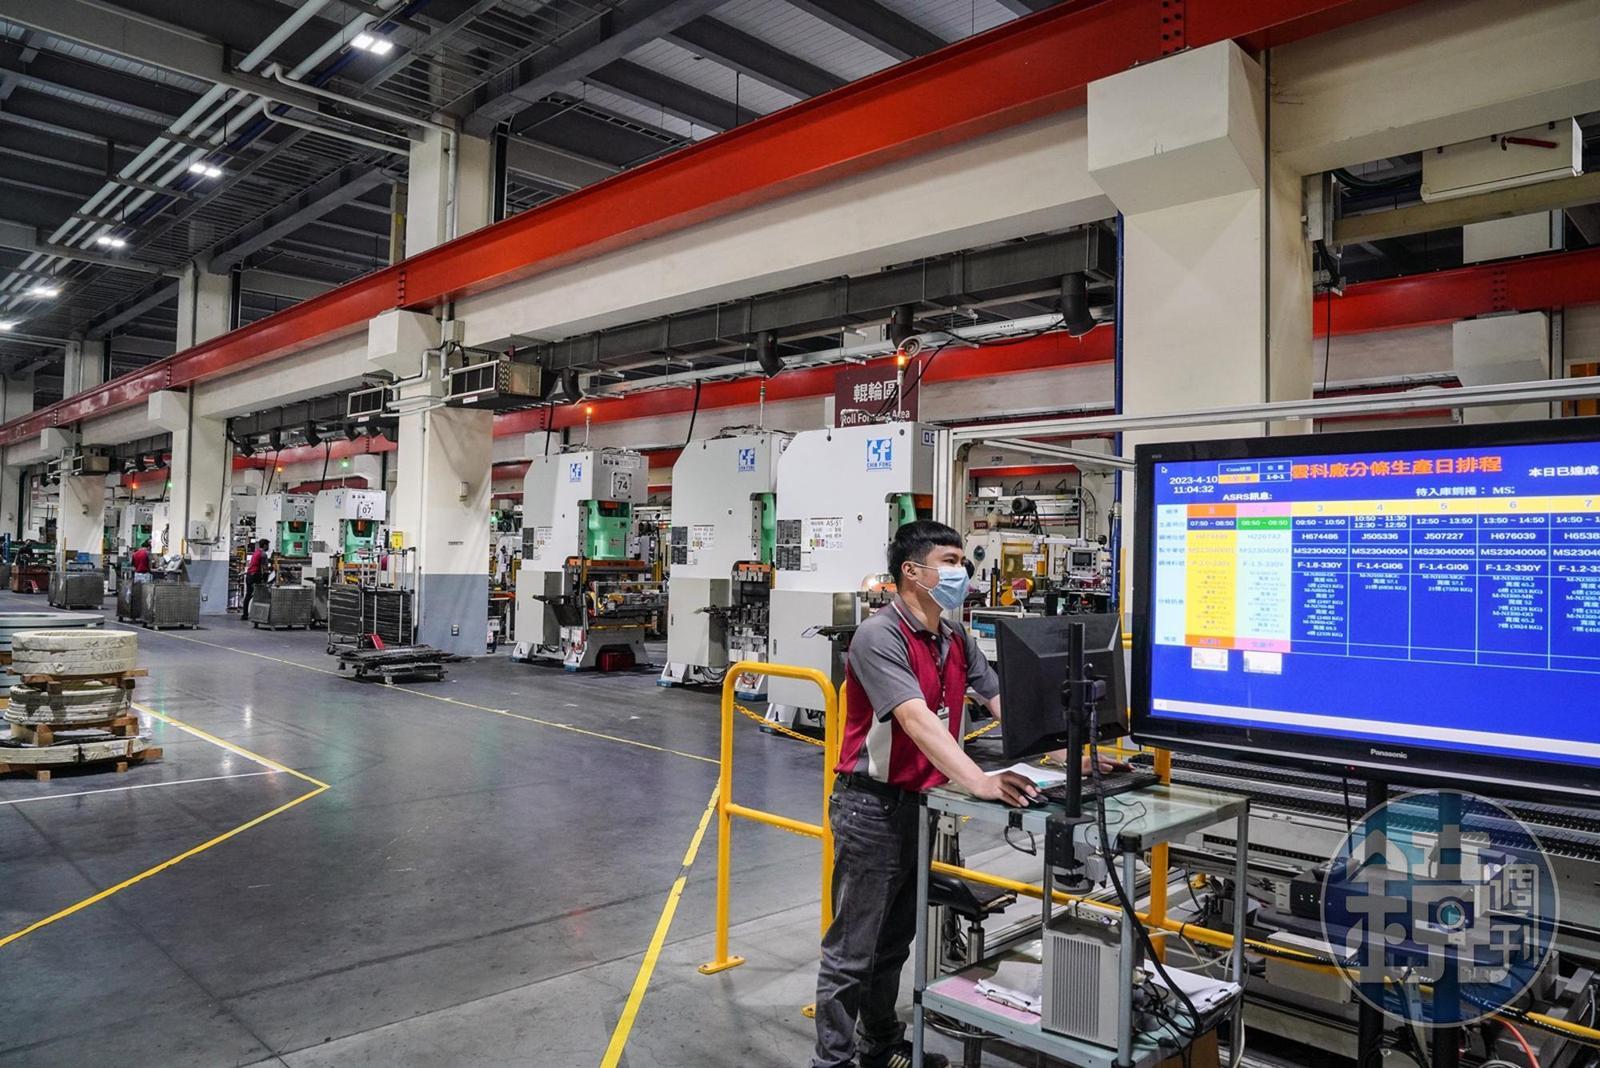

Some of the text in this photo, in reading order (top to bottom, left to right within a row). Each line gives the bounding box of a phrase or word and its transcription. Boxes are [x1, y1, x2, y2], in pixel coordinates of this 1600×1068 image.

[1169, 475, 1218, 485] 2023-4-10
[617, 480, 629, 490] 74
[1173, 485, 1215, 494] 11:04:32
[1440, 502, 1448, 510] 5
[1509, 500, 1518, 508] 6
[1584, 498, 1593, 507] 7
[362, 506, 372, 514] 07
[1519, 516, 1545, 524] 14:50
[1556, 516, 1583, 524] 14:50
[1490, 532, 1536, 540] H676039
[1480, 548, 1547, 556] MS23040006
[1370, 748, 1408, 759] Panasonic
